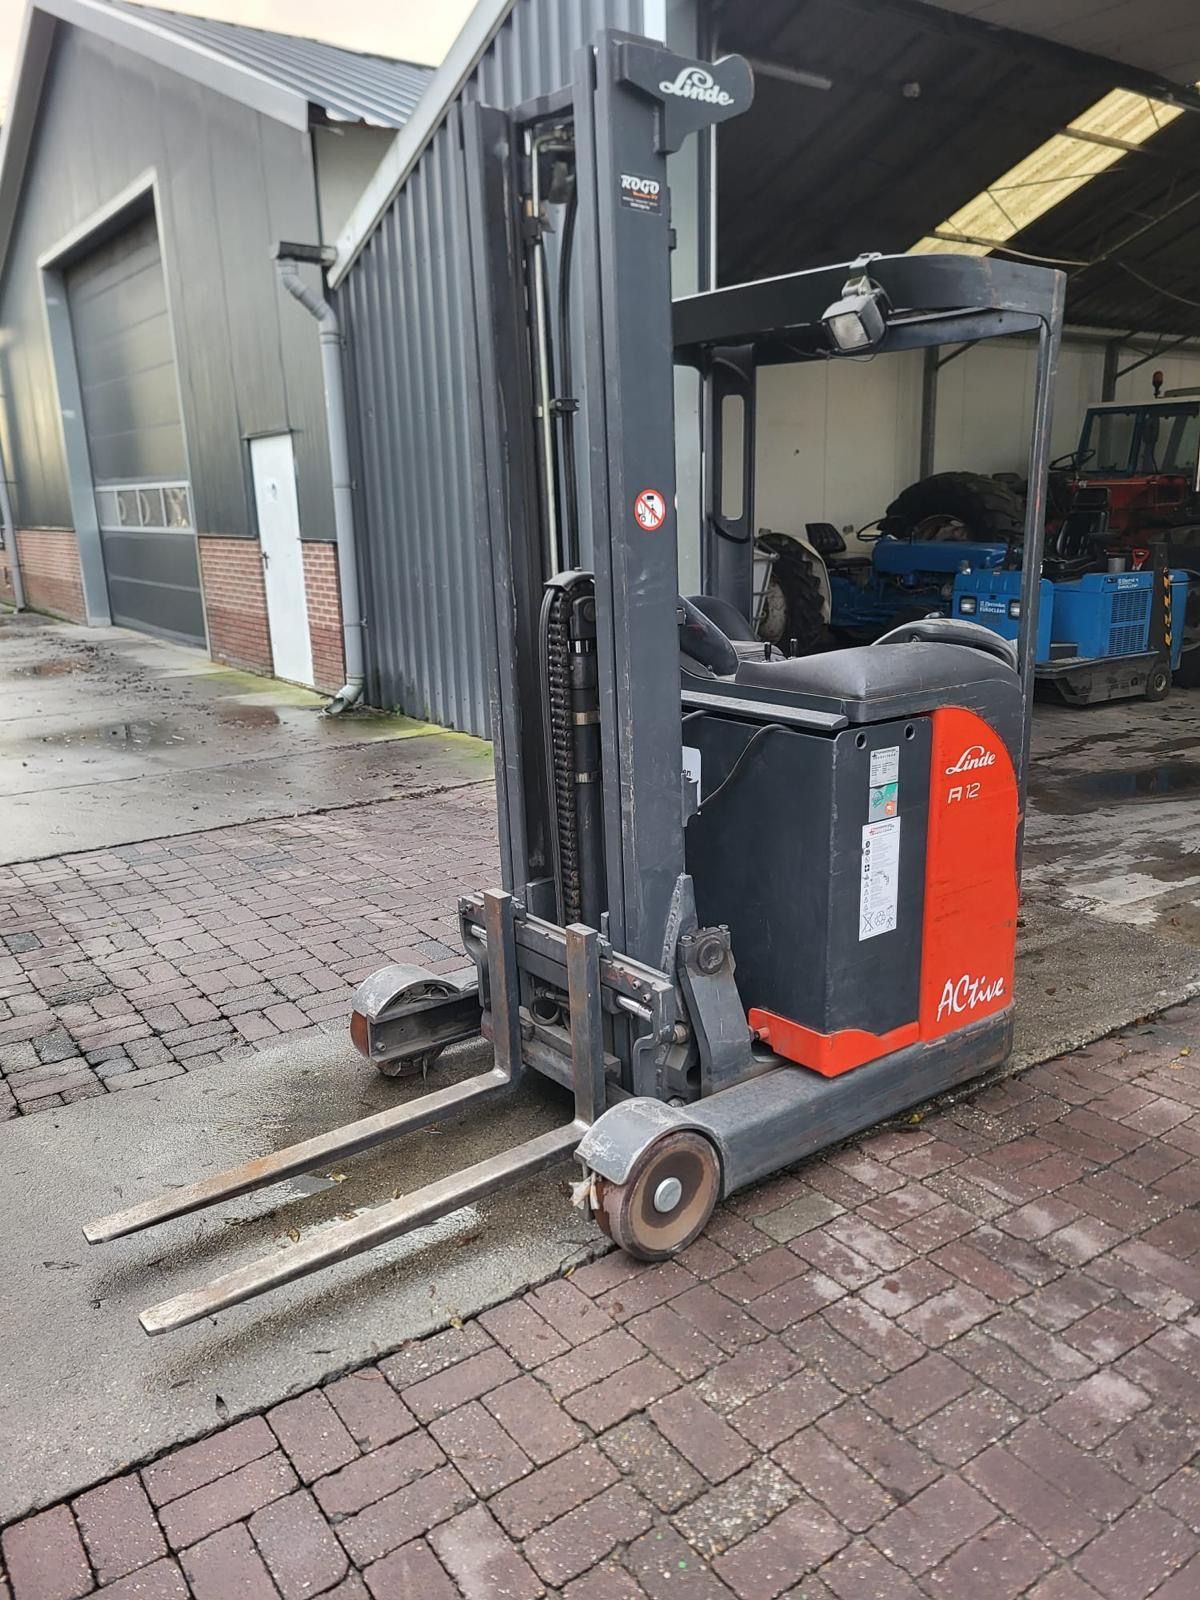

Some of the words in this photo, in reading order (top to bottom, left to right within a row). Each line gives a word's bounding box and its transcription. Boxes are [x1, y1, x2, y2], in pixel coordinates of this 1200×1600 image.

[659, 67, 734, 106] Linde
[620, 174, 660, 195] ROGO
[945, 745, 996, 775] Linde
